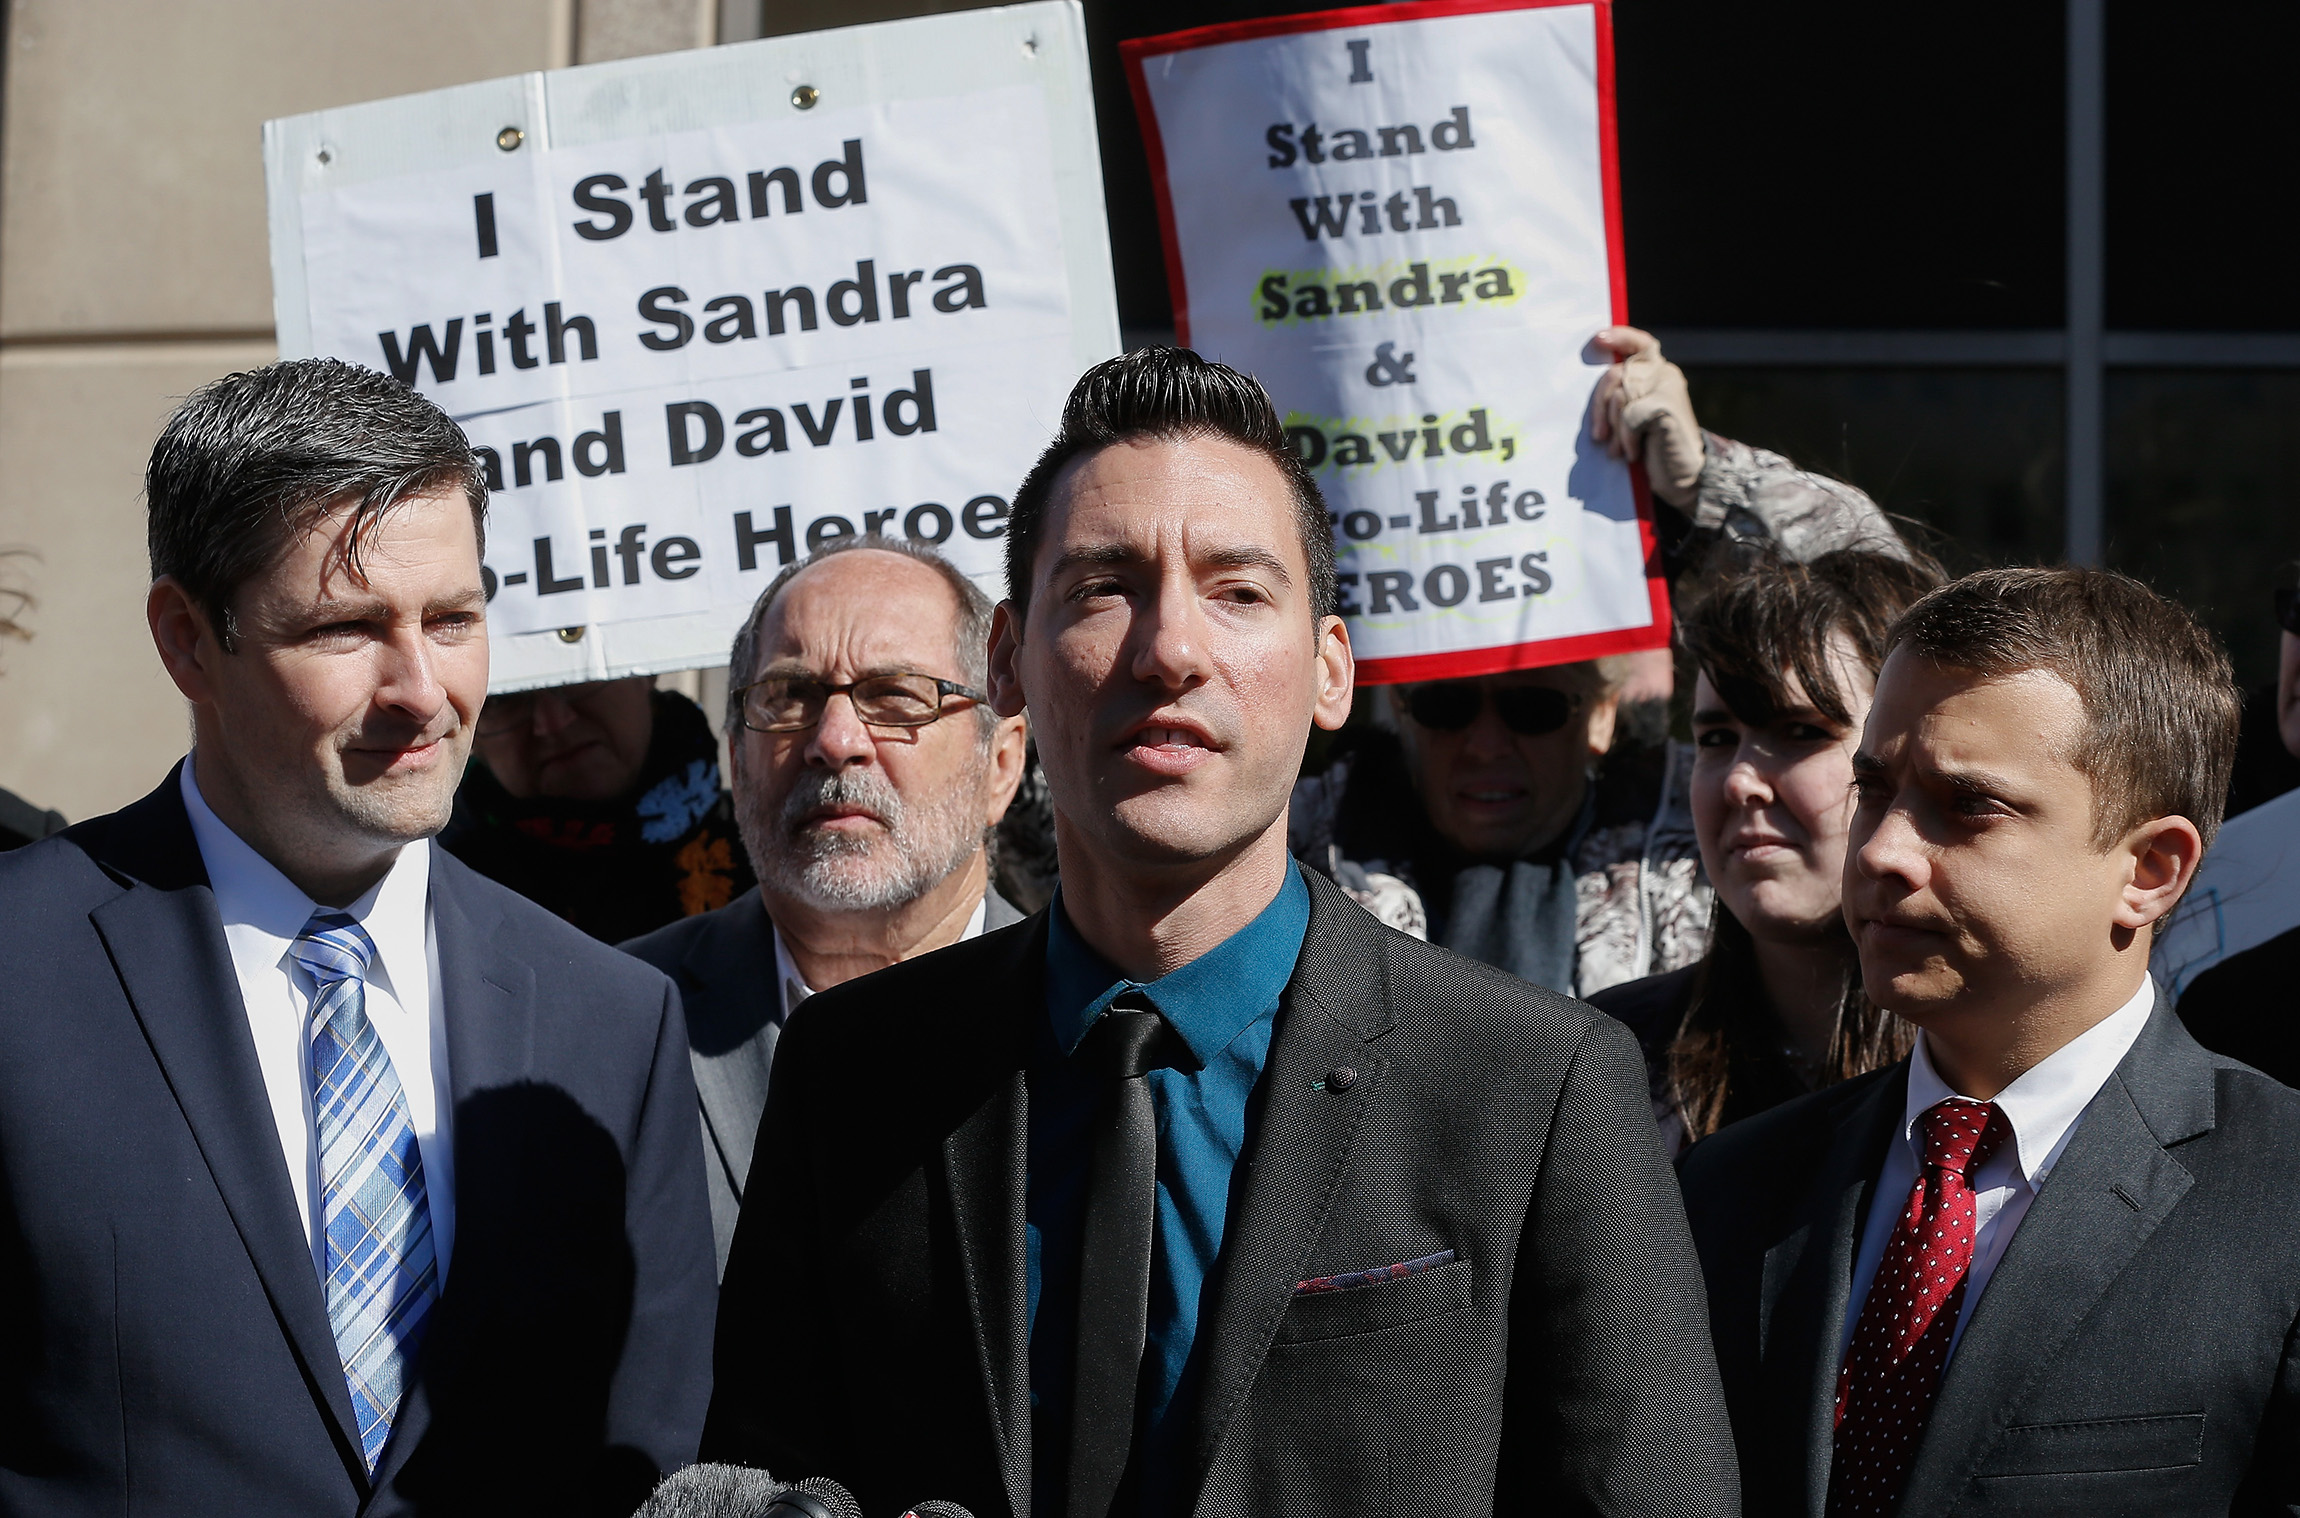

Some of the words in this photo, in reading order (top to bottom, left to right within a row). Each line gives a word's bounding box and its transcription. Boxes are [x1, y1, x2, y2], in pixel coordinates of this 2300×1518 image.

[1346, 39, 1374, 84] I
[1266, 107, 1475, 168] Stand
[474, 193, 498, 258] I
[573, 139, 867, 240] Stand
[1290, 186, 1462, 241] With
[1260, 263, 1514, 320] Sandra
[379, 302, 598, 387] With
[638, 260, 986, 351] Sandra
[1365, 341, 1417, 387] &
[470, 410, 626, 491] and
[666, 369, 937, 466] David
[1287, 409, 1515, 469] David,
[1331, 481, 1546, 541] o-Life
